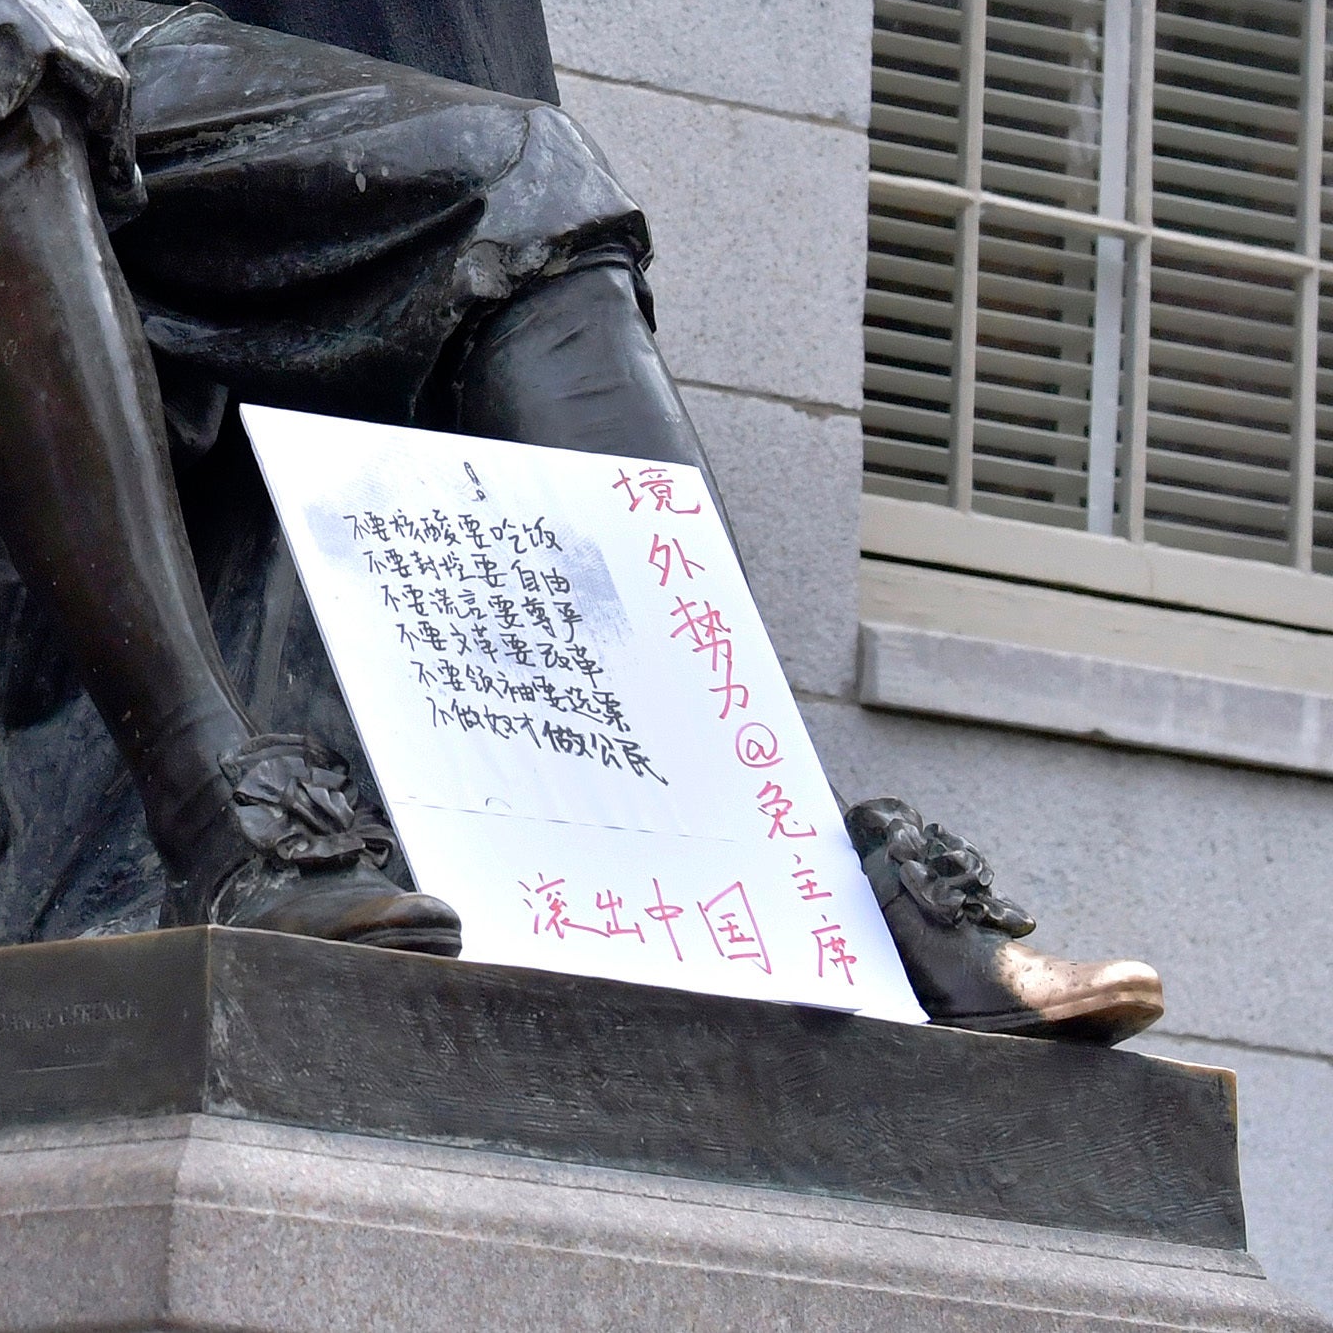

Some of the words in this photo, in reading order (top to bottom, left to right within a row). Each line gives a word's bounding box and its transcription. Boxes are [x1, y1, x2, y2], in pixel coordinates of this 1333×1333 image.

[343, 509, 563, 554] 不要核酸要吃饭
[363, 549, 571, 596] 不要封控要自由
[396, 622, 605, 689] 不要文革要改革
[411, 658, 632, 733] 不要领袖要选票
[426, 695, 670, 787] 不做奴才做公民
[517, 872, 772, 974] 滚出中国
